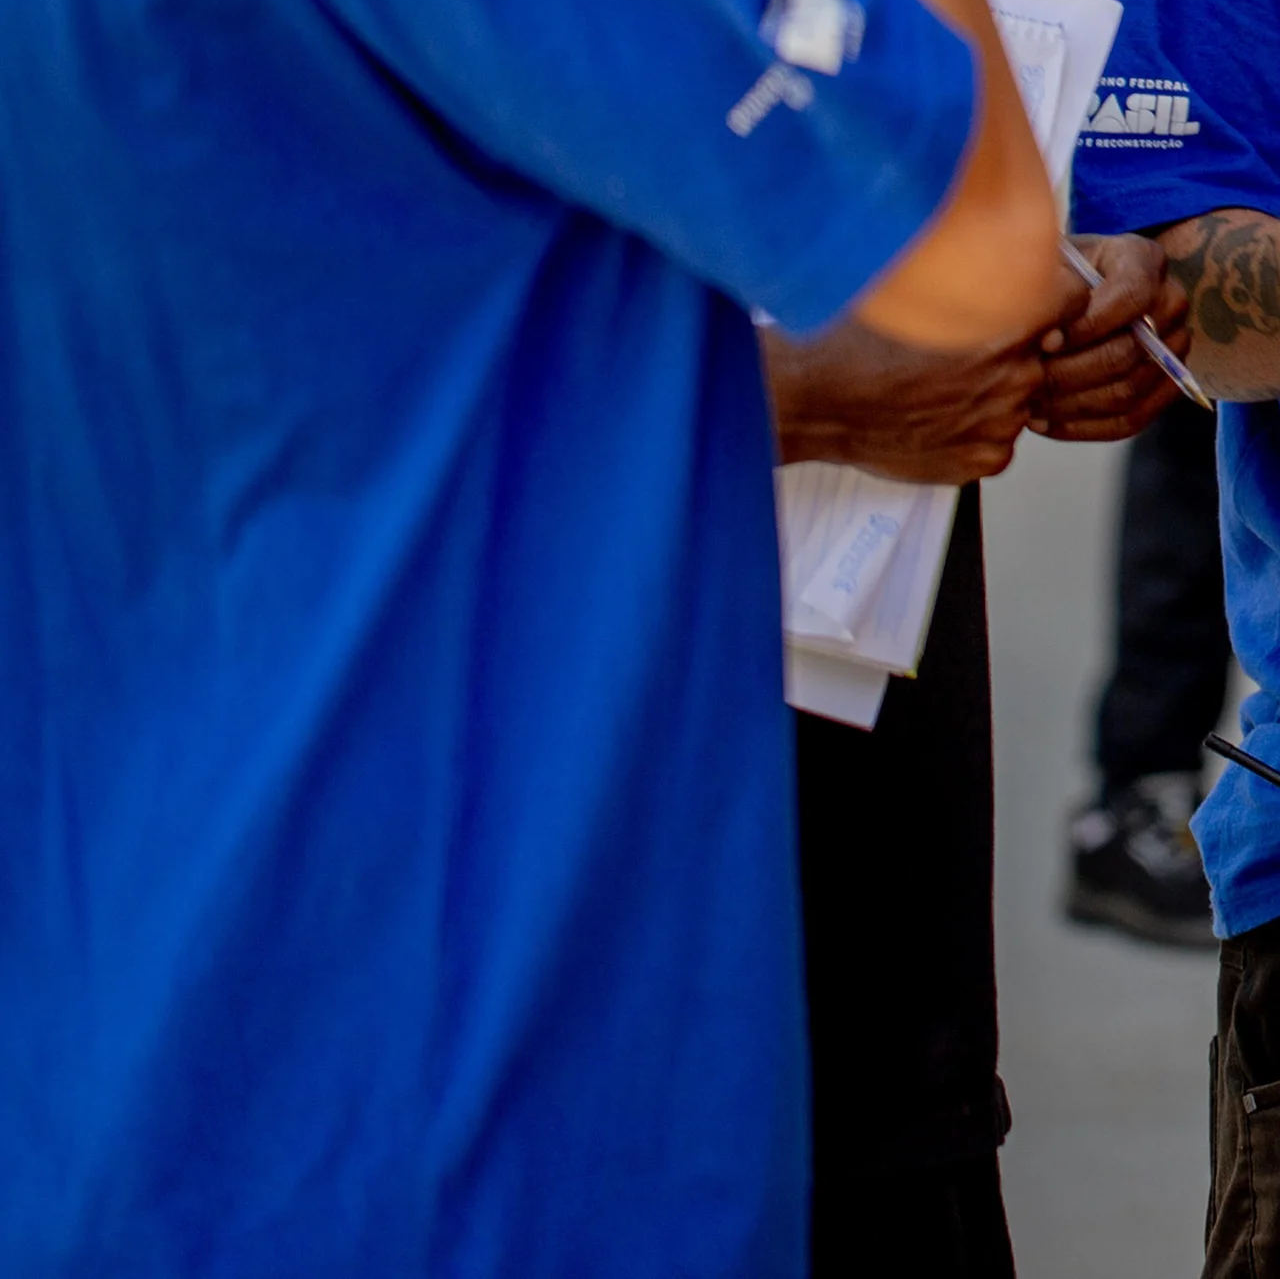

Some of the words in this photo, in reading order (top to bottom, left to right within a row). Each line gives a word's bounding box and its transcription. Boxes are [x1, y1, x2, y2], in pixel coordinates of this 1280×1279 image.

[1128, 77, 1190, 92] FEDERAL
[1080, 92, 1201, 136] ASIL
[1095, 137, 1184, 150] RECONSTRUÇÃO
